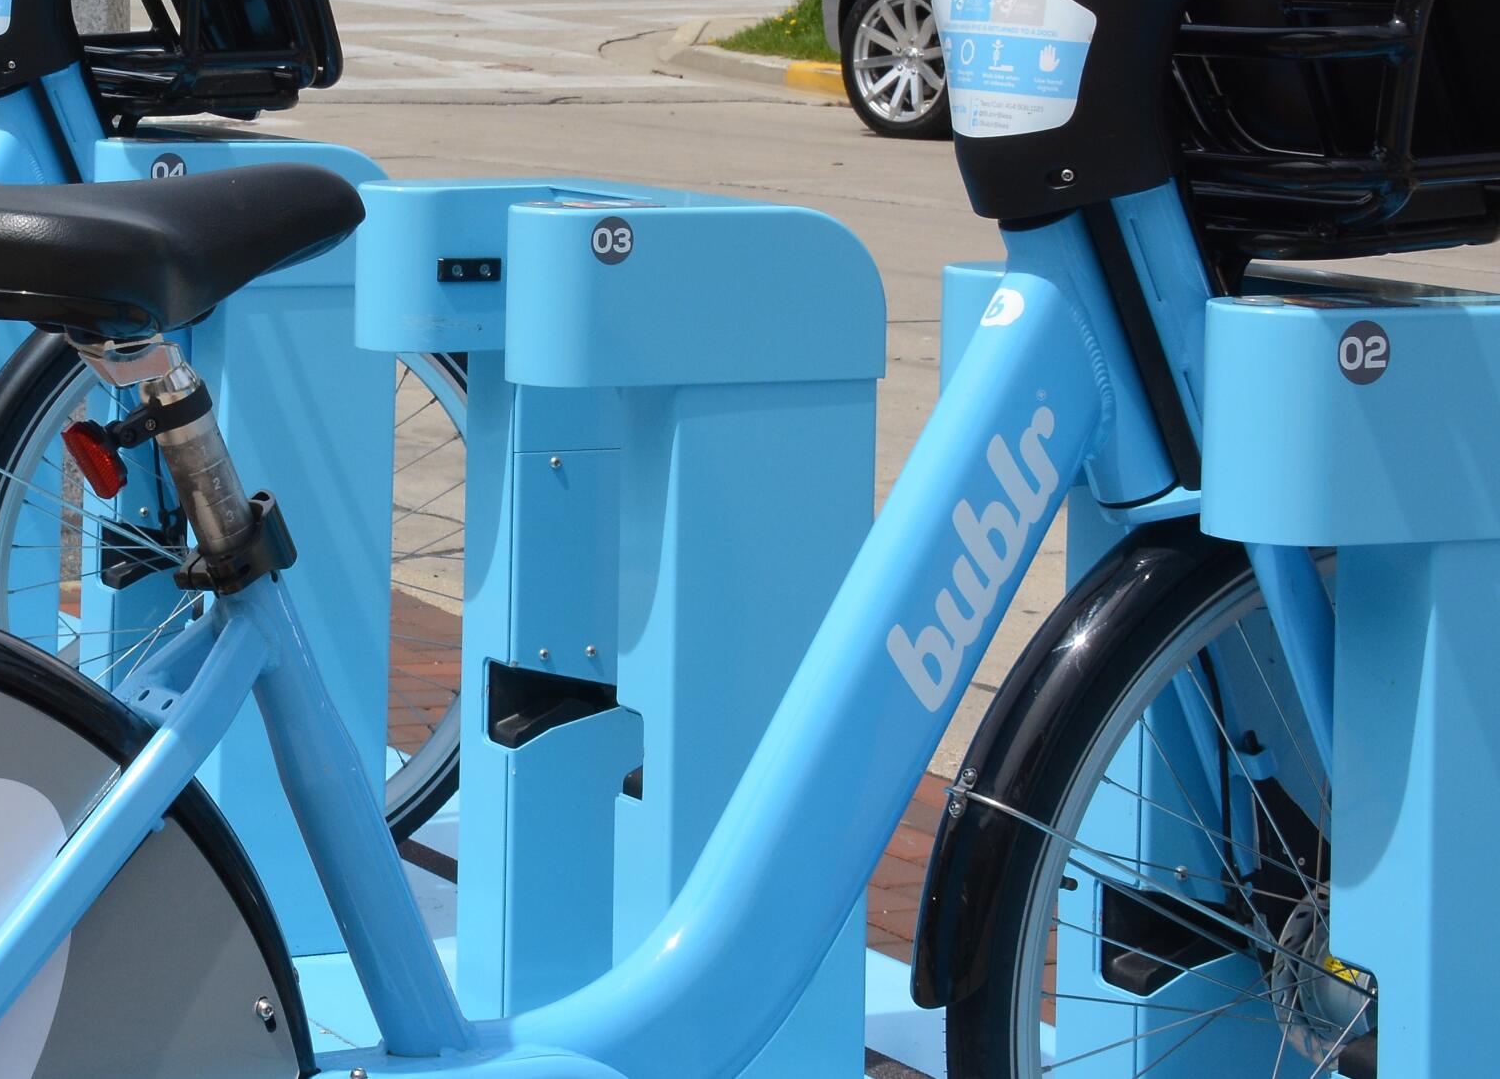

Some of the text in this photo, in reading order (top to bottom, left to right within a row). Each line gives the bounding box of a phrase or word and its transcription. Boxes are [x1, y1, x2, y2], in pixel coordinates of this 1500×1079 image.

[592, 227, 632, 254] 03
[1338, 335, 1388, 371] 02
[886, 405, 1059, 712] bublr
